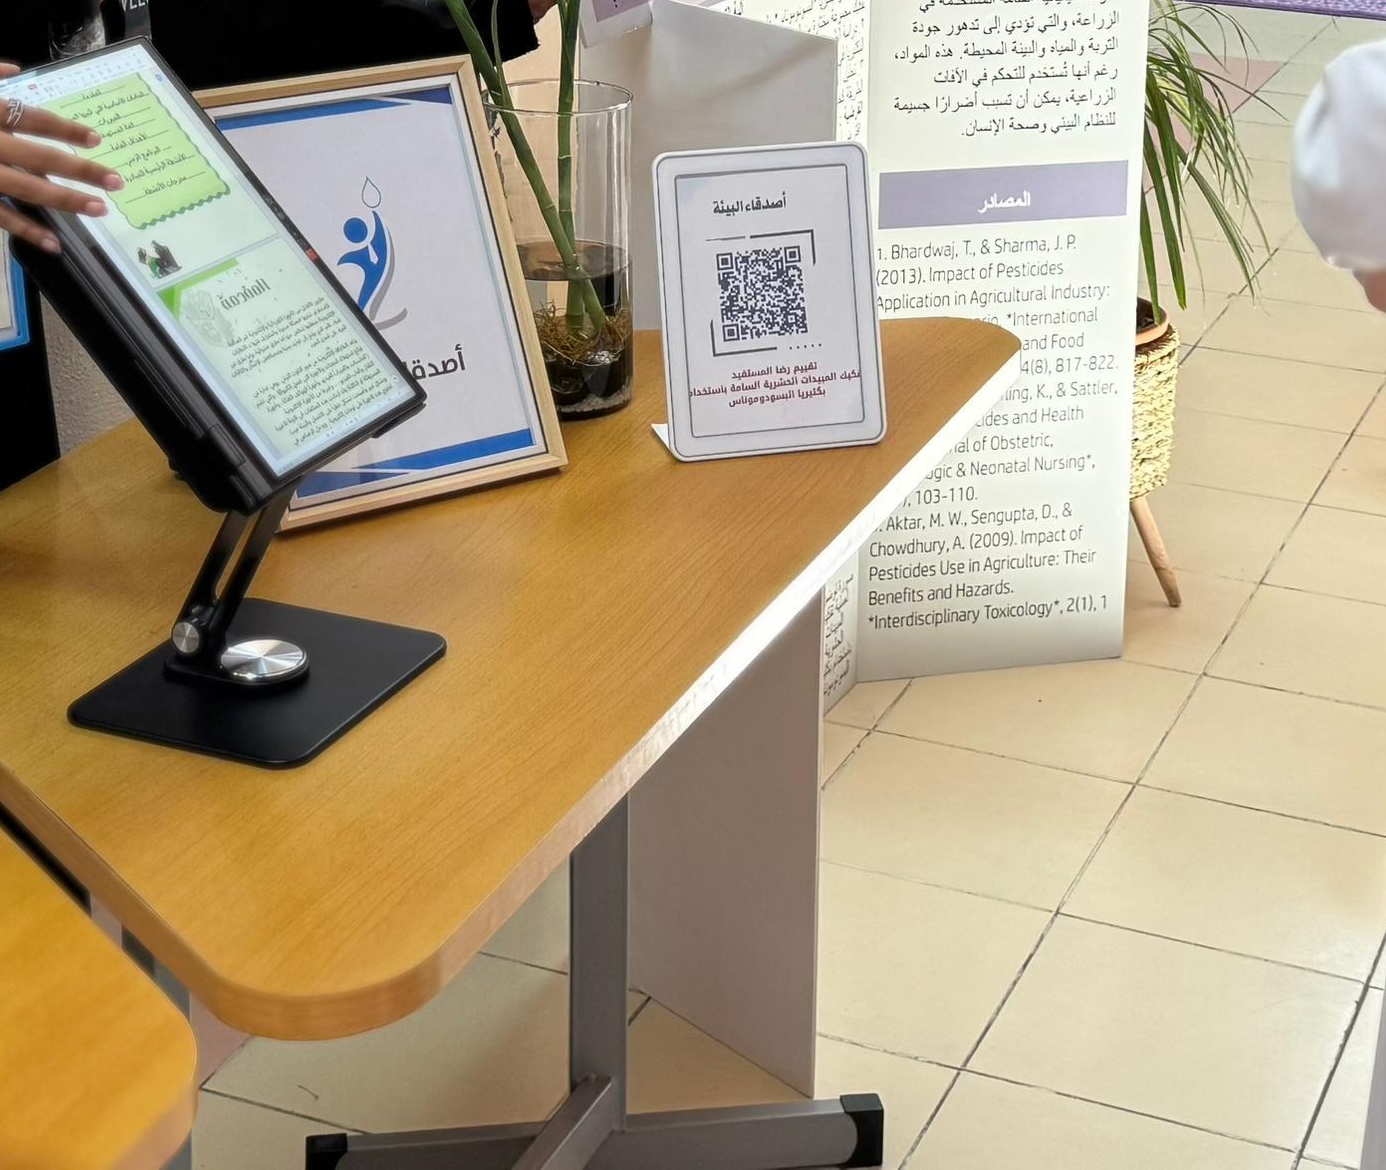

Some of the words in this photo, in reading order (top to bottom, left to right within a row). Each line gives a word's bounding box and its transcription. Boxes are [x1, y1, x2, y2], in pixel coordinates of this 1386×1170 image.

[912, 21, 941, 37] جودة
[946, 18, 980, 36] تدهور
[983, 15, 1001, 35] إلى
[1005, 17, 1035, 35] تؤدي
[1038, 13, 1068, 33] والتي
[1071, 10, 1120, 30] الزراعة،
[934, 43, 953, 58] هذه
[959, 41, 1007, 60] المحيطة.
[1011, 40, 1046, 58] والبيئة
[1050, 39, 1085, 56] والمياه
[1088, 36, 1119, 52] التربة
[894, 45, 931, 63] المواد،
[934, 69, 968, 84] الآفات
[972, 71, 987, 87] في
[991, 66, 1025, 85] للتحكم
[1071, 61, 1090, 81] أنها
[1094, 67, 1118, 81] رغم
[982, 94, 1012, 109] تسبب
[1016, 89, 1029, 108] أن
[1033, 91, 1061, 108] يمكن
[1065, 87, 1116, 105] الزراعية،
[894, 97, 931, 114] جسيمة
[961, 118, 1005, 137] الإنسان.
[1009, 118, 1046, 134] وصحة
[1051, 113, 1080, 134] البيئي
[1084, 111, 1116, 128] للنظام
[713, 200, 743, 216] البيئة
[745, 191, 787, 212] أصدقاء
[978, 190, 1031, 214] المصادر
[877, 247, 887, 261] 1.
[891, 241, 958, 260] Bhardwaj,
[963, 240, 976, 257] T.,
[980, 239, 991, 254] &
[994, 237, 1050, 255] Sharma,
[1054, 235, 1063, 250] J.
[1066, 234, 1077, 250] P.
[875, 267, 926, 287] (2013).
[929, 265, 975, 284] Impact
[979, 263, 992, 279] of
[997, 261, 1064, 278] Pesticides
[876, 293, 950, 312] Application
[954, 291, 966, 306] in
[970, 287, 1047, 307] Agricultural
[1051, 284, 1110, 301] Industry:
[1022, 335, 1047, 351] and
[1051, 333, 1084, 349] Food
[775, 365, 791, 376] رضا
[793, 362, 817, 376] تقييم
[1055, 355, 1118, 372] 817-822.
[731, 367, 773, 380] المستفيد
[801, 372, 837, 385] المبيدات
[730, 380, 760, 393] السامة
[763, 376, 798, 390] الحشرية
[1037, 383, 1052, 399] K.,
[1056, 382, 1066, 397] &
[1070, 380, 1118, 397] Sattler,
[728, 391, 795, 407] البسودوموناس
[798, 387, 826, 399] بكتيريا
[1012, 409, 1037, 425] and
[1041, 405, 1084, 423] Health
[973, 436, 987, 452] of
[991, 432, 1054, 451] Obstetric,
[956, 462, 967, 478] &
[970, 457, 1030, 476] Neonatal
[915, 486, 978, 505] 103-110.
[886, 516, 926, 532] Aktar,
[929, 512, 944, 527] M.
[948, 510, 968, 527] W.,
[971, 506, 1038, 526] Sengupta,
[1042, 503, 1058, 520] D.,
[1062, 502, 1073, 517] &
[869, 539, 950, 558] Chowdhury,
[952, 535, 965, 551] A.
[969, 530, 1018, 550] (2009).
[1020, 529, 1065, 545] Impact
[1069, 525, 1084, 541] of
[869, 563, 936, 581] Pesticides
[940, 559, 965, 575] Use
[969, 557, 980, 573] in
[983, 552, 1059, 574] Agriculture:
[1063, 549, 1098, 565] Their
[869, 586, 924, 606] Benefits
[927, 583, 952, 601] and
[956, 579, 1014, 598] Hazards.
[1066, 595, 1097, 613] 2(1),
[1101, 595, 1108, 609] 1
